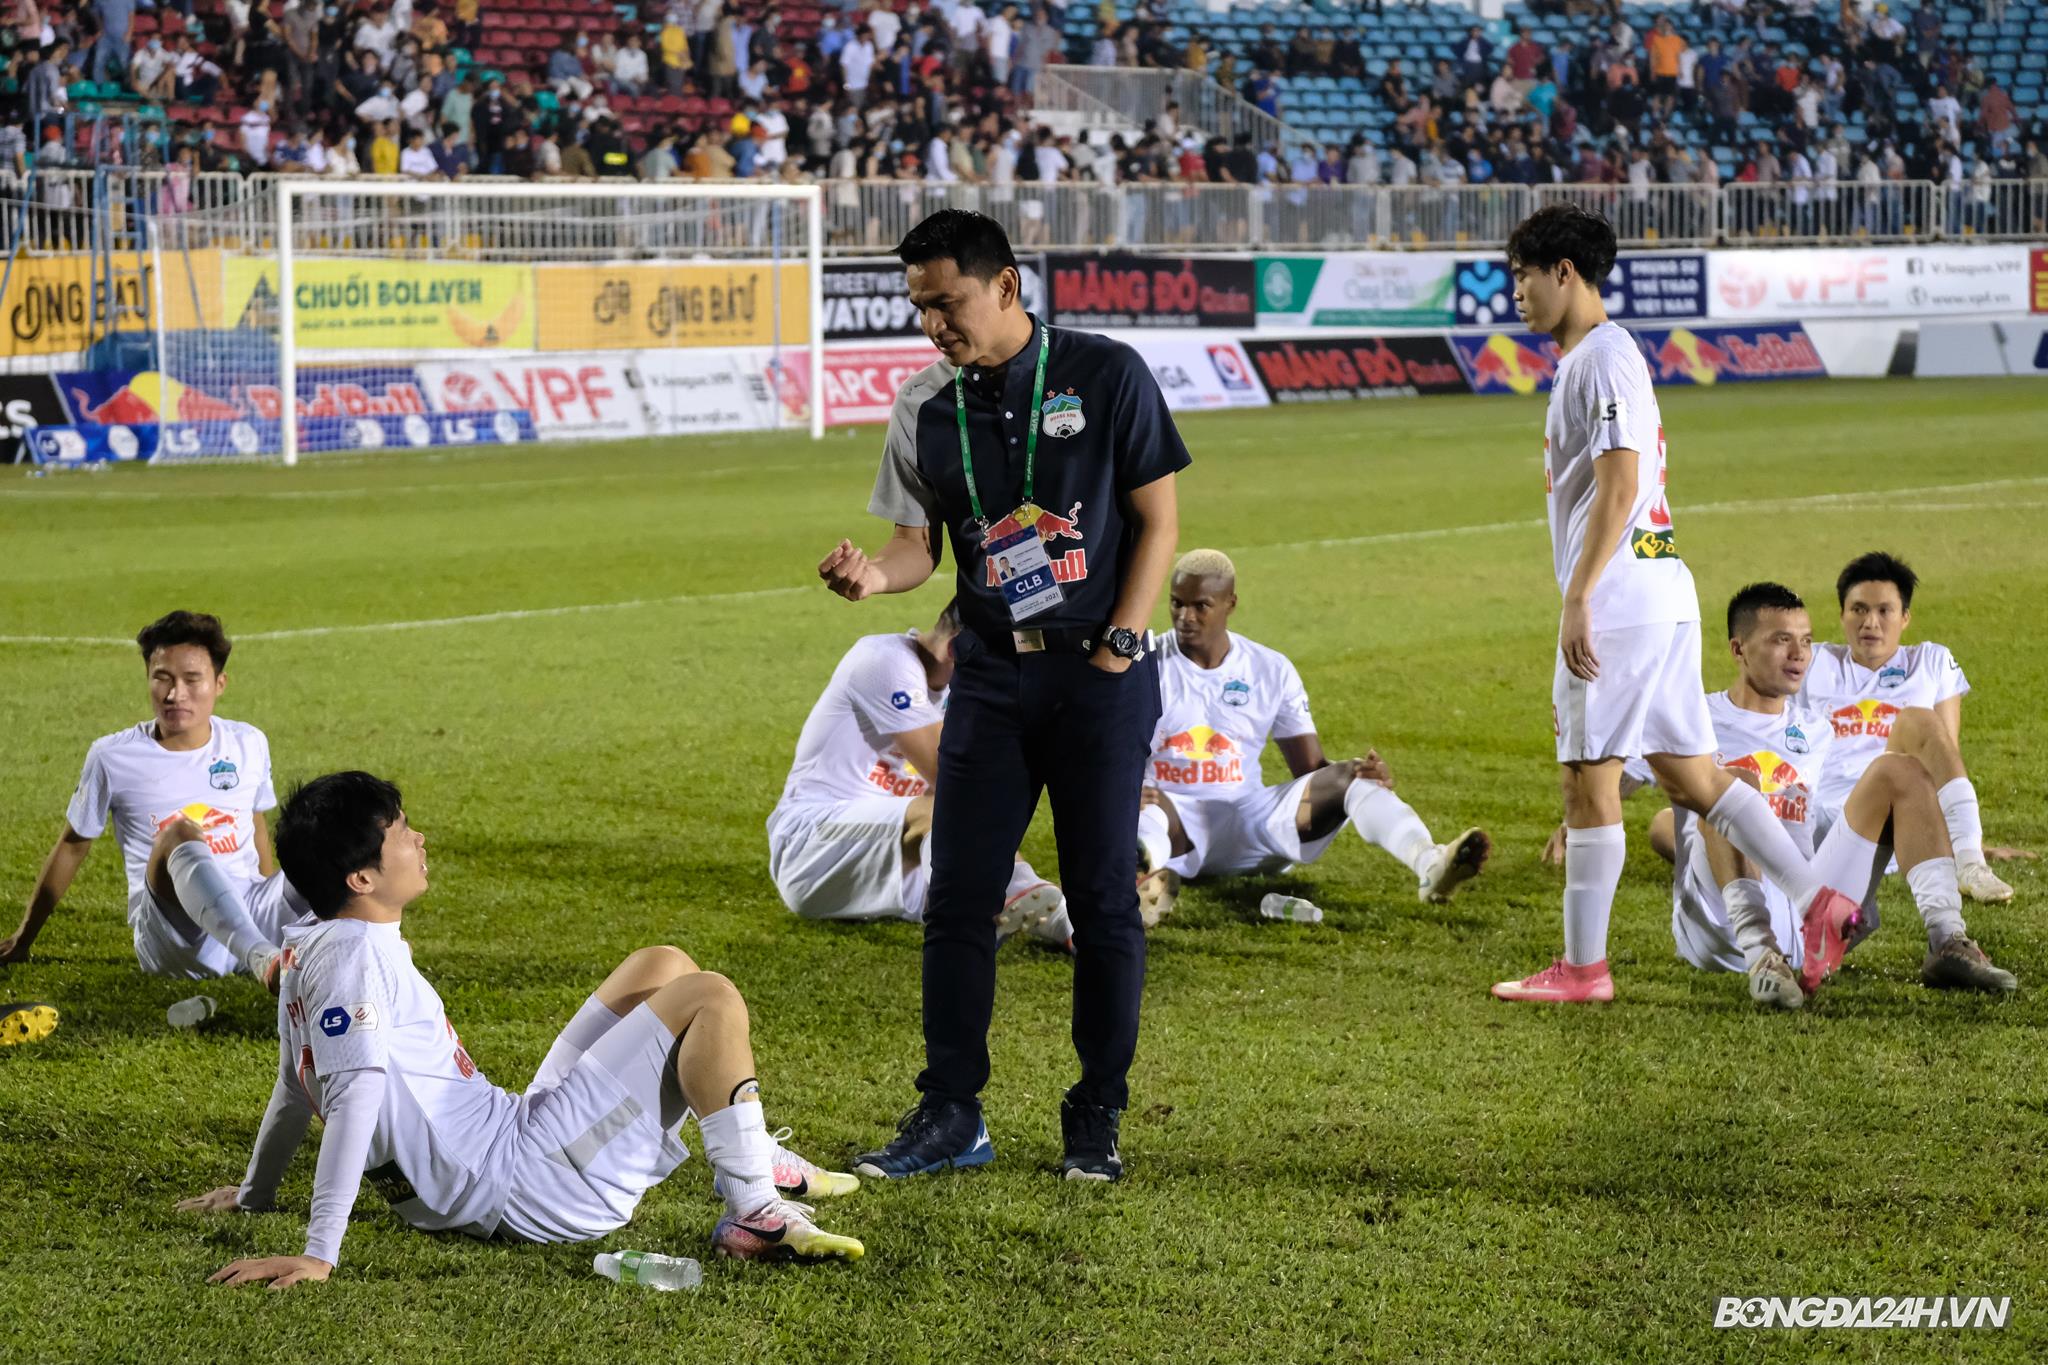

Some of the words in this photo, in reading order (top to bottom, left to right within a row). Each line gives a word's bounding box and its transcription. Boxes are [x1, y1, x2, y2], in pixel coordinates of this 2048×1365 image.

[494, 367, 614, 425] VPF
[1050, 549, 1088, 584] ull
[1015, 574, 1043, 594] CLB
[1866, 721, 1891, 738] Bu
[1154, 760, 1198, 784] Red
[324, 1016, 342, 1028] LS
